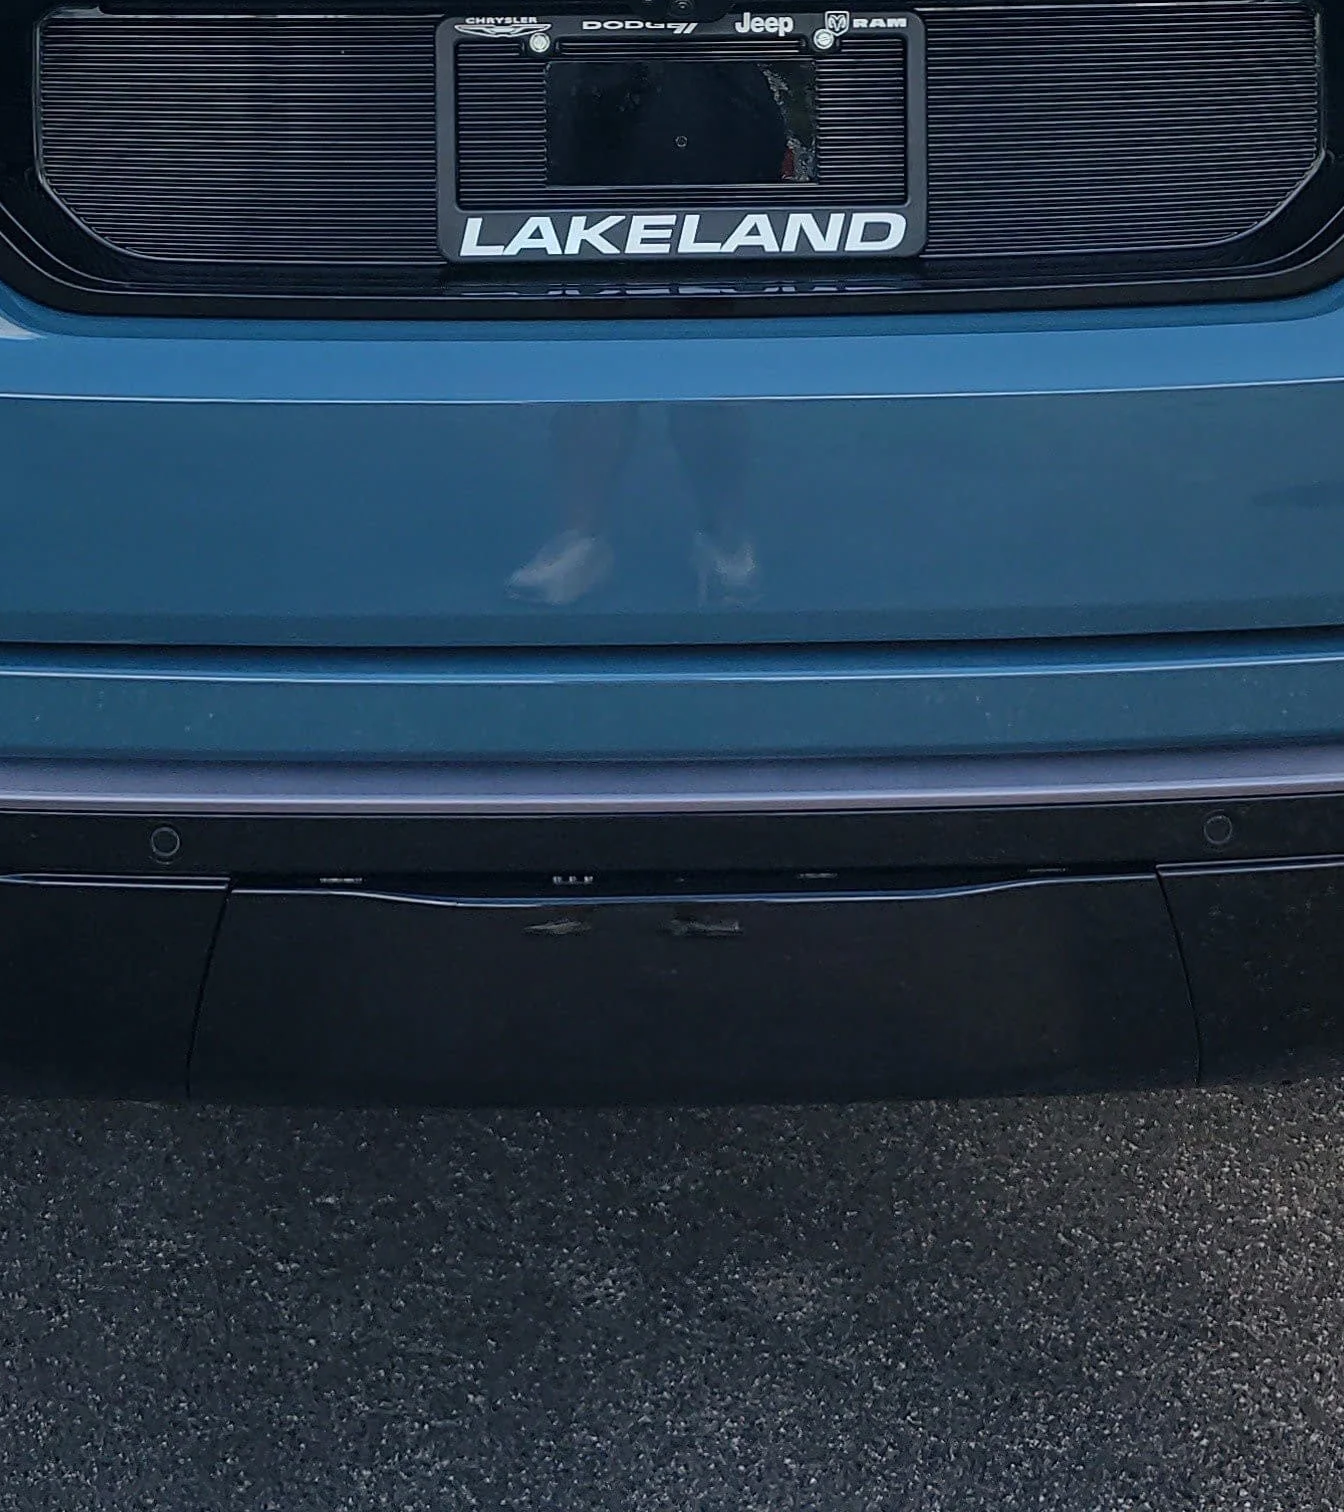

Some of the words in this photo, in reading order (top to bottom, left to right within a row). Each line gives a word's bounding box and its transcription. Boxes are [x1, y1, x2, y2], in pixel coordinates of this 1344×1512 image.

[465, 16, 538, 25] CHRYSLER
[734, 11, 794, 37] Jeep
[852, 17, 908, 28] RAM
[459, 212, 908, 257] LAKELAND
